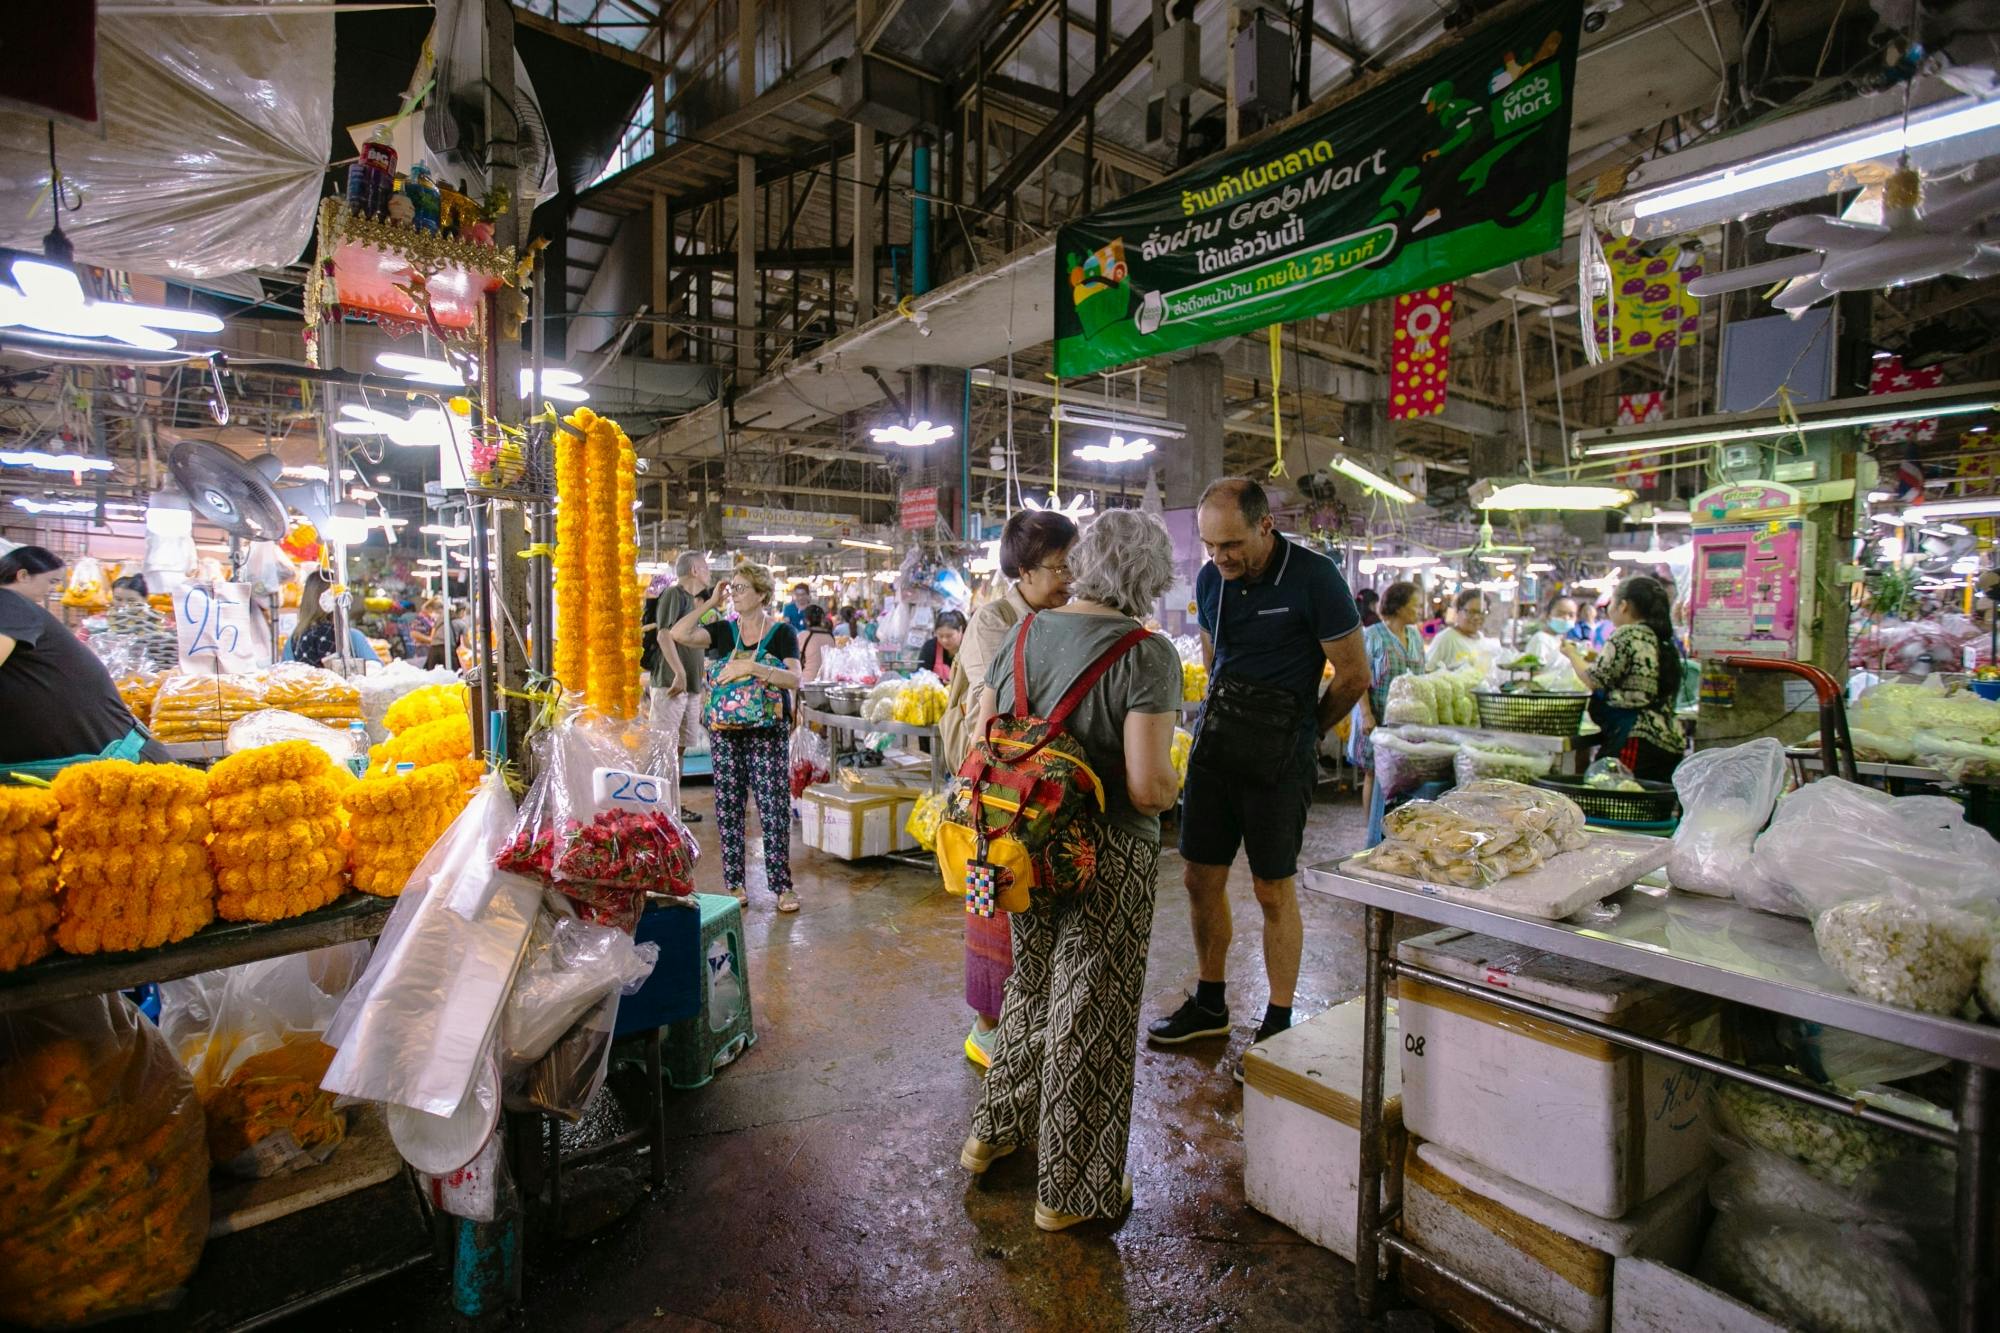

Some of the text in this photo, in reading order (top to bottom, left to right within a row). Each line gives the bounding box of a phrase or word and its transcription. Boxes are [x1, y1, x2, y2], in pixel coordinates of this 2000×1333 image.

[1502, 76, 1549, 108] Grab
[1503, 92, 1552, 123] Mart
[1141, 148, 1387, 262] สั่งผ่าน GrabMart
[1181, 140, 1334, 216] ร้านค้าในตลาด
[1197, 212, 1306, 275] ได้แล้ววันนี้!
[1255, 260, 1308, 292] ภายใน
[1311, 252, 1335, 276] 25
[1339, 237, 1377, 267] นาที
[184, 584, 240, 657] 25
[605, 771, 658, 804] 20
[1404, 1032, 1427, 1057] 08
